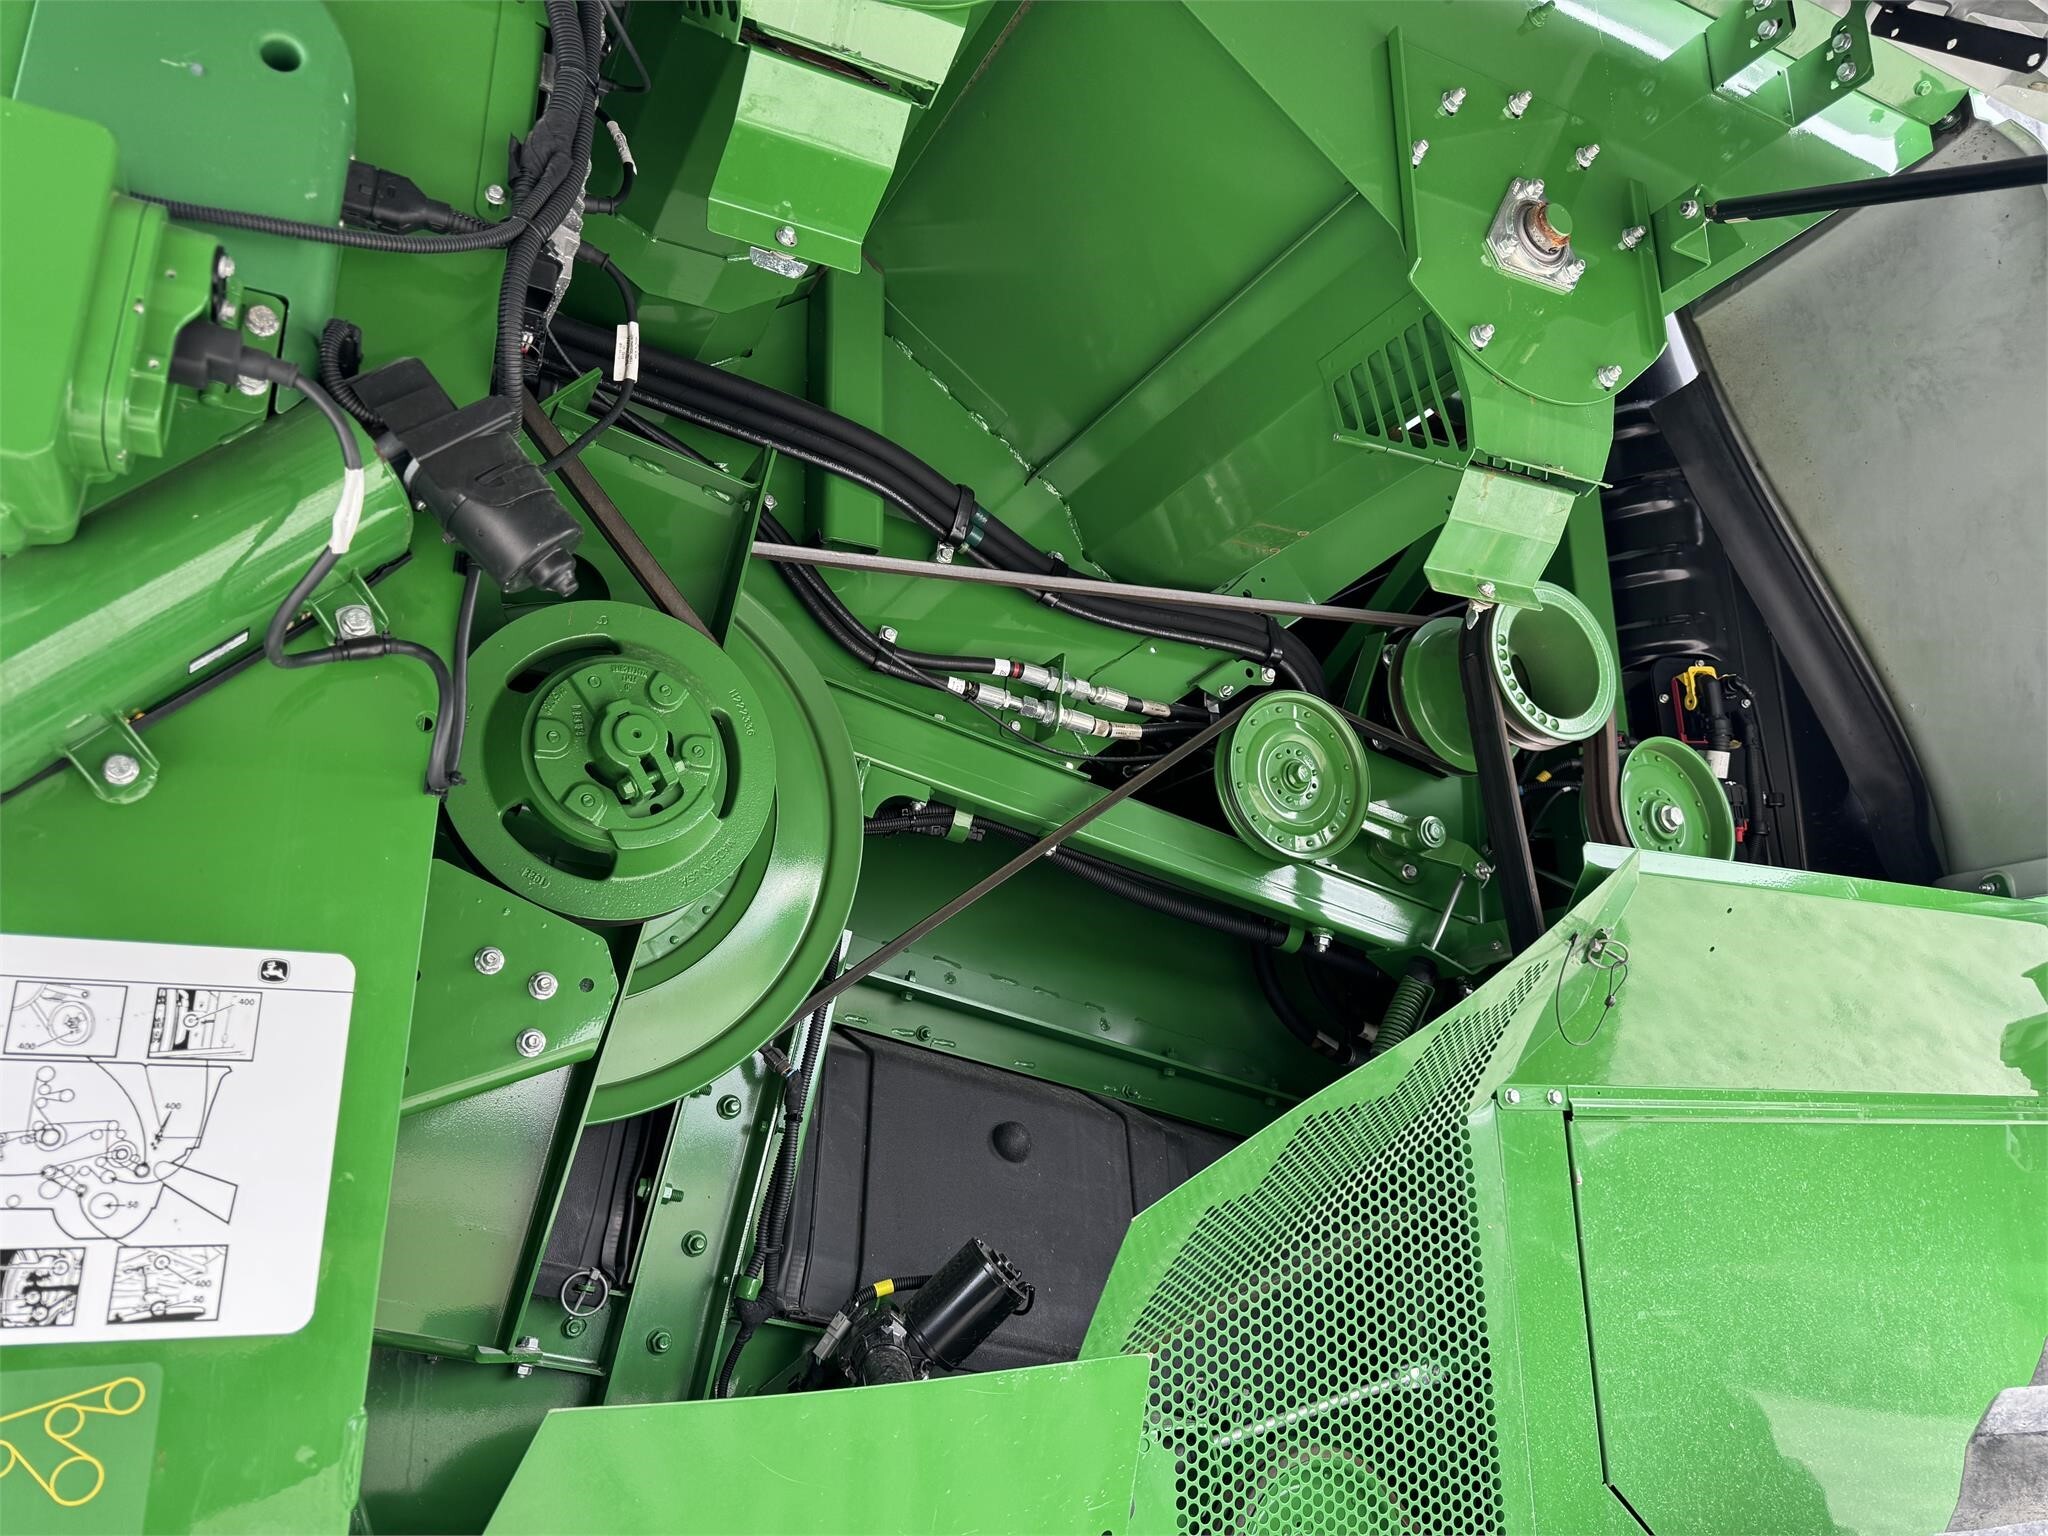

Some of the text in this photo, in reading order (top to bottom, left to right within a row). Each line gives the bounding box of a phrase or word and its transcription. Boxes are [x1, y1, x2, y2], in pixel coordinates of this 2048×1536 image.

[238, 998, 255, 1006] 400
[17, 1042, 37, 1050] 400
[164, 1102, 182, 1110] 400
[194, 1280, 212, 1288] 400
[192, 1296, 205, 1304] 50
